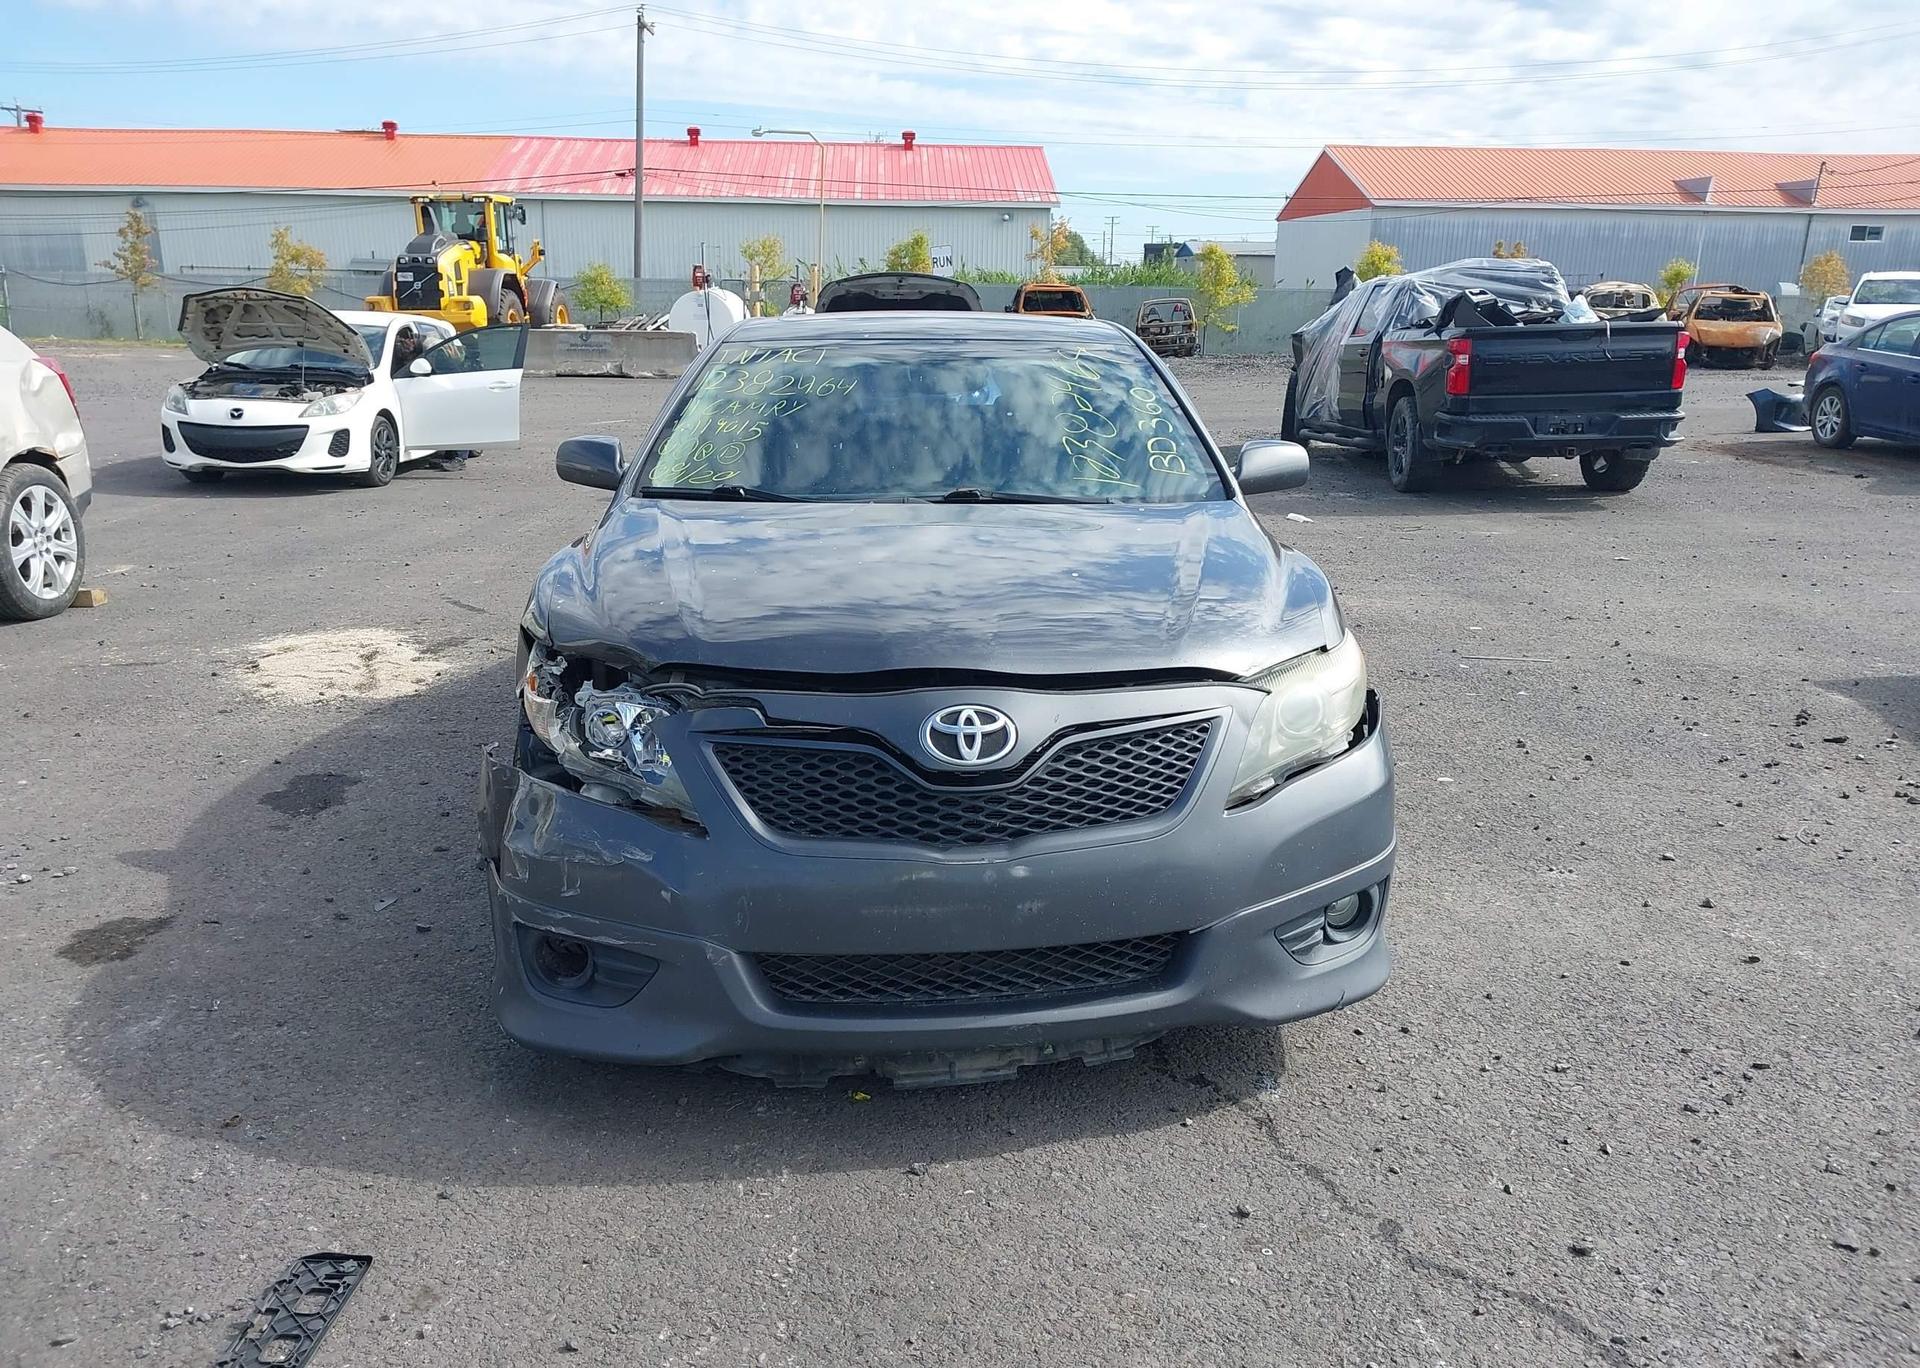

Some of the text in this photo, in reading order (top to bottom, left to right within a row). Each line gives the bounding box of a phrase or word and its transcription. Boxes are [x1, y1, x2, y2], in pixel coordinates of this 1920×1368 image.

[932, 255, 953, 268] RUN
[711, 347, 836, 366] INTACT
[694, 368, 859, 398] 12382464
[702, 399, 808, 418] CAMRY
